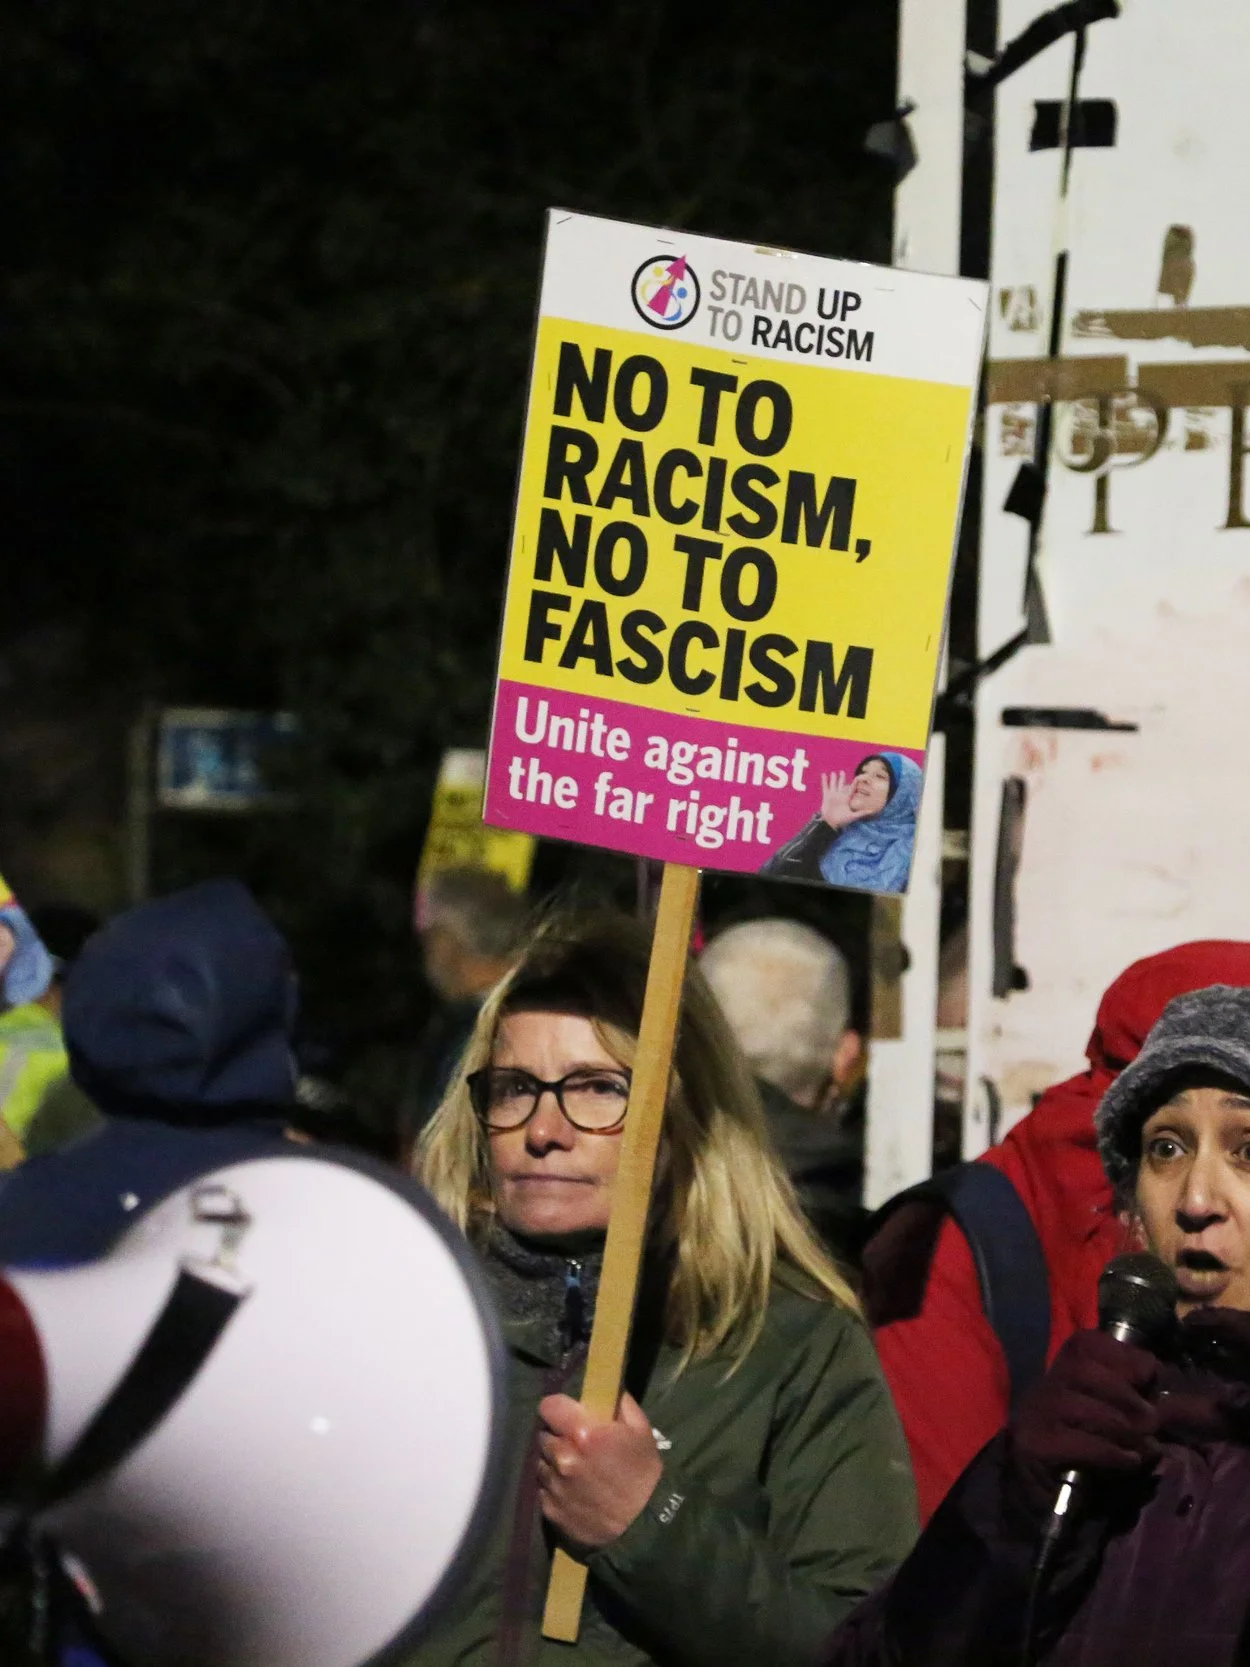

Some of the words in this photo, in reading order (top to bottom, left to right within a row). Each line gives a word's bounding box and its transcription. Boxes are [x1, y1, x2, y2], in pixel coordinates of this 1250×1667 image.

[707, 304, 743, 342] TO
[751, 314, 875, 362] RACISM
[709, 269, 807, 315] STAND
[817, 287, 862, 322] UP
[552, 341, 669, 433] NO
[689, 366, 793, 458] TO
[542, 424, 872, 564] RACISM,
[533, 507, 649, 598] NO
[673, 533, 778, 622] TO
[522, 588, 876, 720] FASCISM
[514, 695, 632, 761] Unite
[644, 737, 810, 793] against
[507, 755, 579, 810] the
[593, 771, 655, 826] far
[665, 793, 774, 850] right
